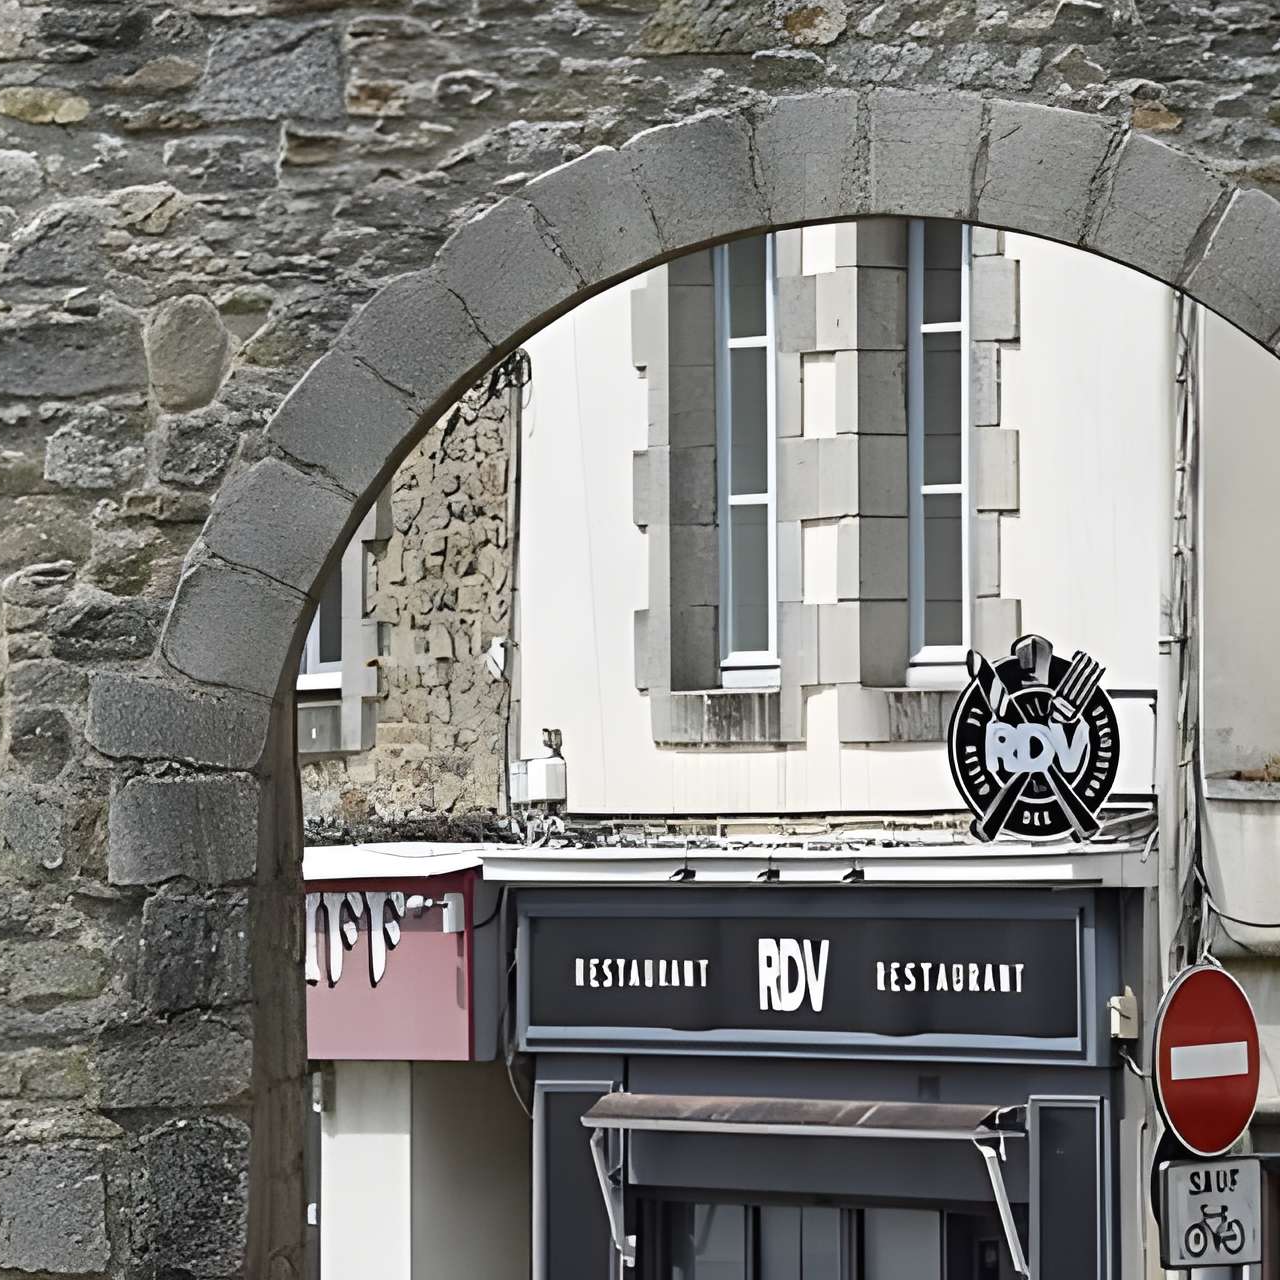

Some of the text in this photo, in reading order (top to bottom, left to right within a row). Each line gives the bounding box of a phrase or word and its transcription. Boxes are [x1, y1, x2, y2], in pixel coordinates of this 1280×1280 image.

[985, 720, 1090, 773] RDV
[575, 938, 1025, 1012] RESTAURANT RDV RESTAURANT
[1188, 1168, 1240, 1195] SAUF
